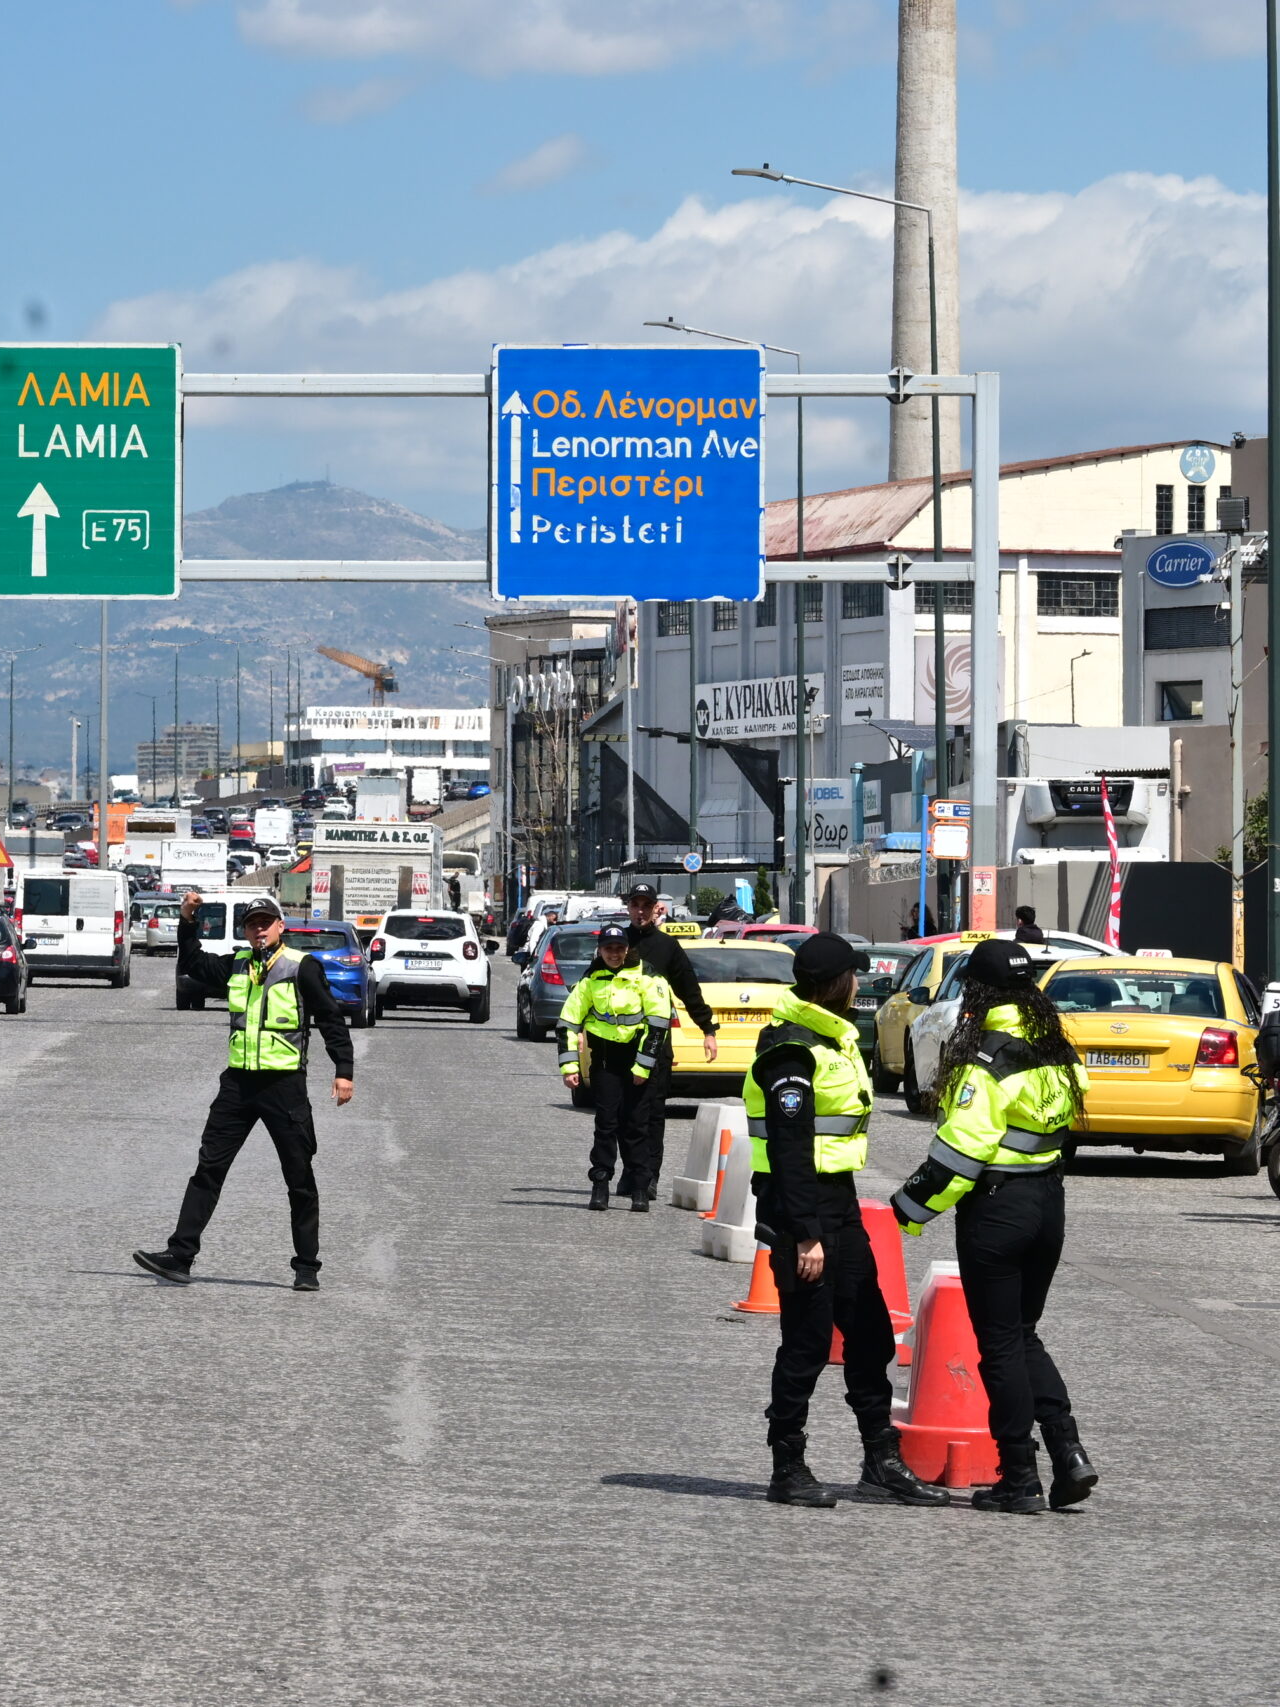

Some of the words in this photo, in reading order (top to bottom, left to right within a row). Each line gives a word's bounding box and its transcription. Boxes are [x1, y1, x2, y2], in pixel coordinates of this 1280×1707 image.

[18, 372, 150, 406] ΛΑΜΙΑ
[533, 389, 586, 418] Οδ.
[594, 389, 757, 426] Λένορμαν
[18, 424, 148, 458] LAMIA
[532, 429, 692, 458] Lenorman
[701, 430, 759, 458] Ave
[532, 467, 703, 504] Περιστέρι
[532, 514, 682, 544] Peristeri
[1156, 554, 1204, 573] Carrier
[666, 925, 695, 933] TAXI
